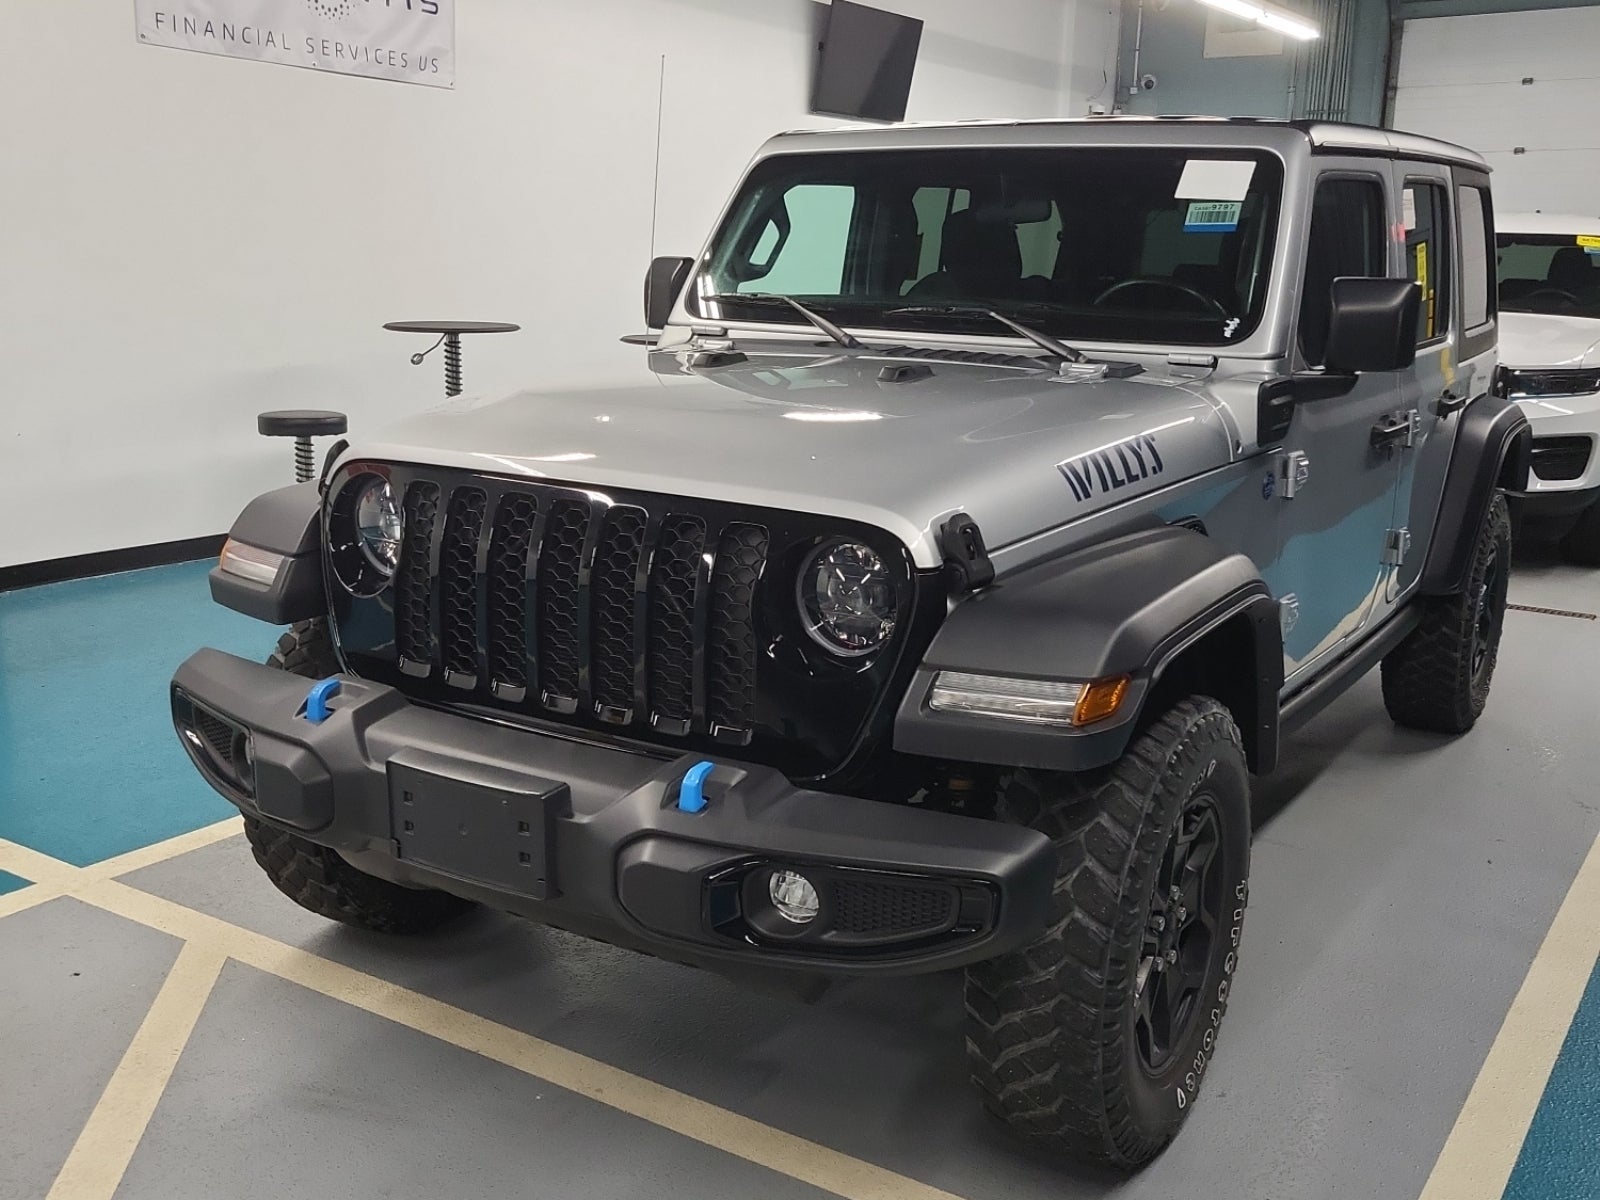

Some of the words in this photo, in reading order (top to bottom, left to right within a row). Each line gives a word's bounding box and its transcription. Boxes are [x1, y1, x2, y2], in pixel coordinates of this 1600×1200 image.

[154, 12, 291, 51] FINANCIAL
[305, 37, 409, 69] SERVICES
[418, 55, 439, 73] US
[1056, 433, 1164, 502] WILLYS
